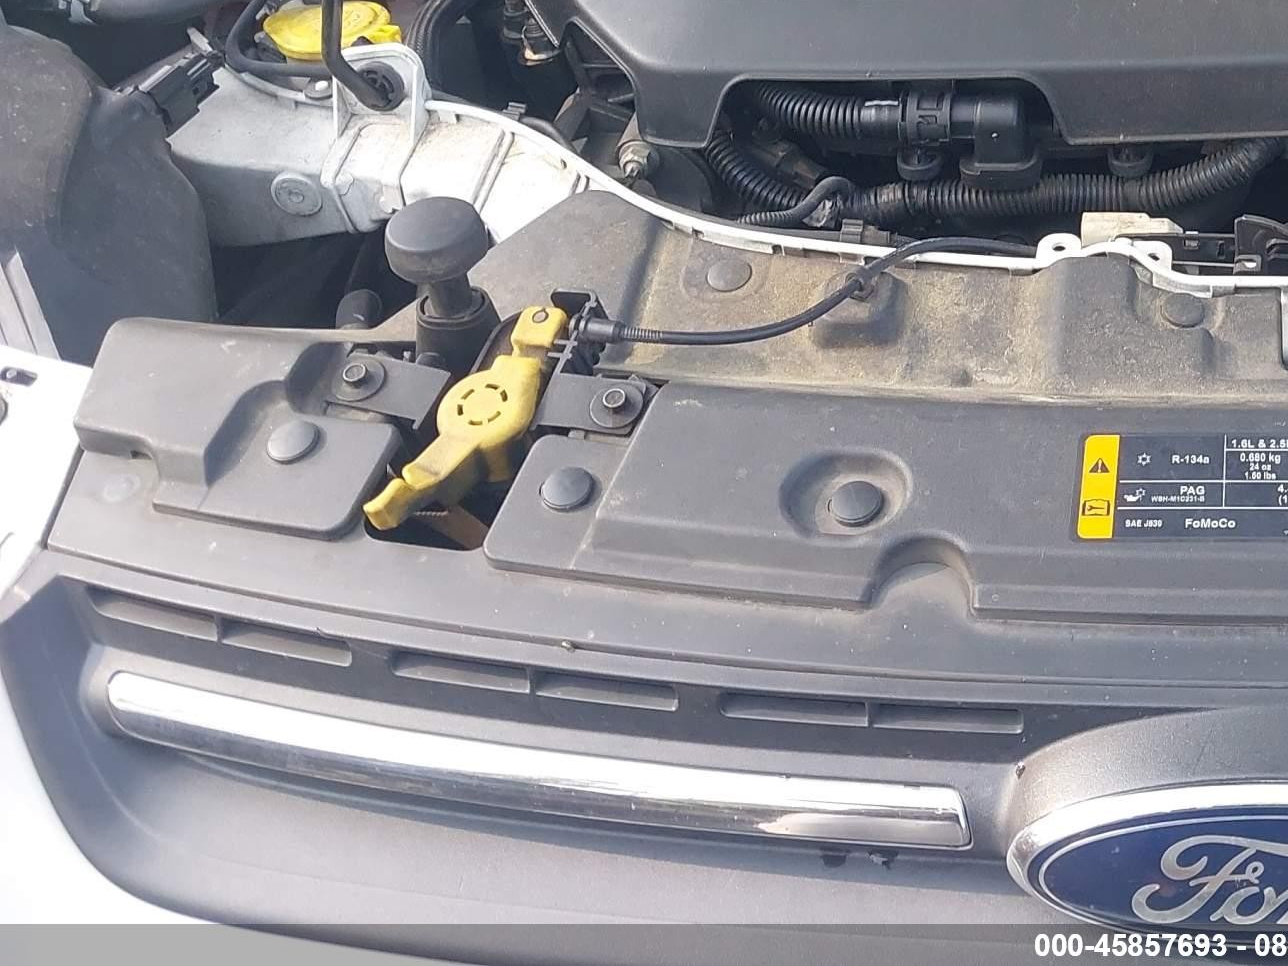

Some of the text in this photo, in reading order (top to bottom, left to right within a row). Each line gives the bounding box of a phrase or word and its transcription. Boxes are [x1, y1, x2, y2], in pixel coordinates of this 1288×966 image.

[1257, 439, 1266, 448] &
[1171, 454, 1210, 465] R-134a
[1240, 452, 1281, 464] 0.680 kg
[1249, 463, 1272, 472] 24 oz
[1263, 472, 1277, 480] lbs
[1180, 485, 1206, 495] PAG
[1125, 519, 1142, 528] SAE
[1184, 518, 1237, 529] FoMoCo
